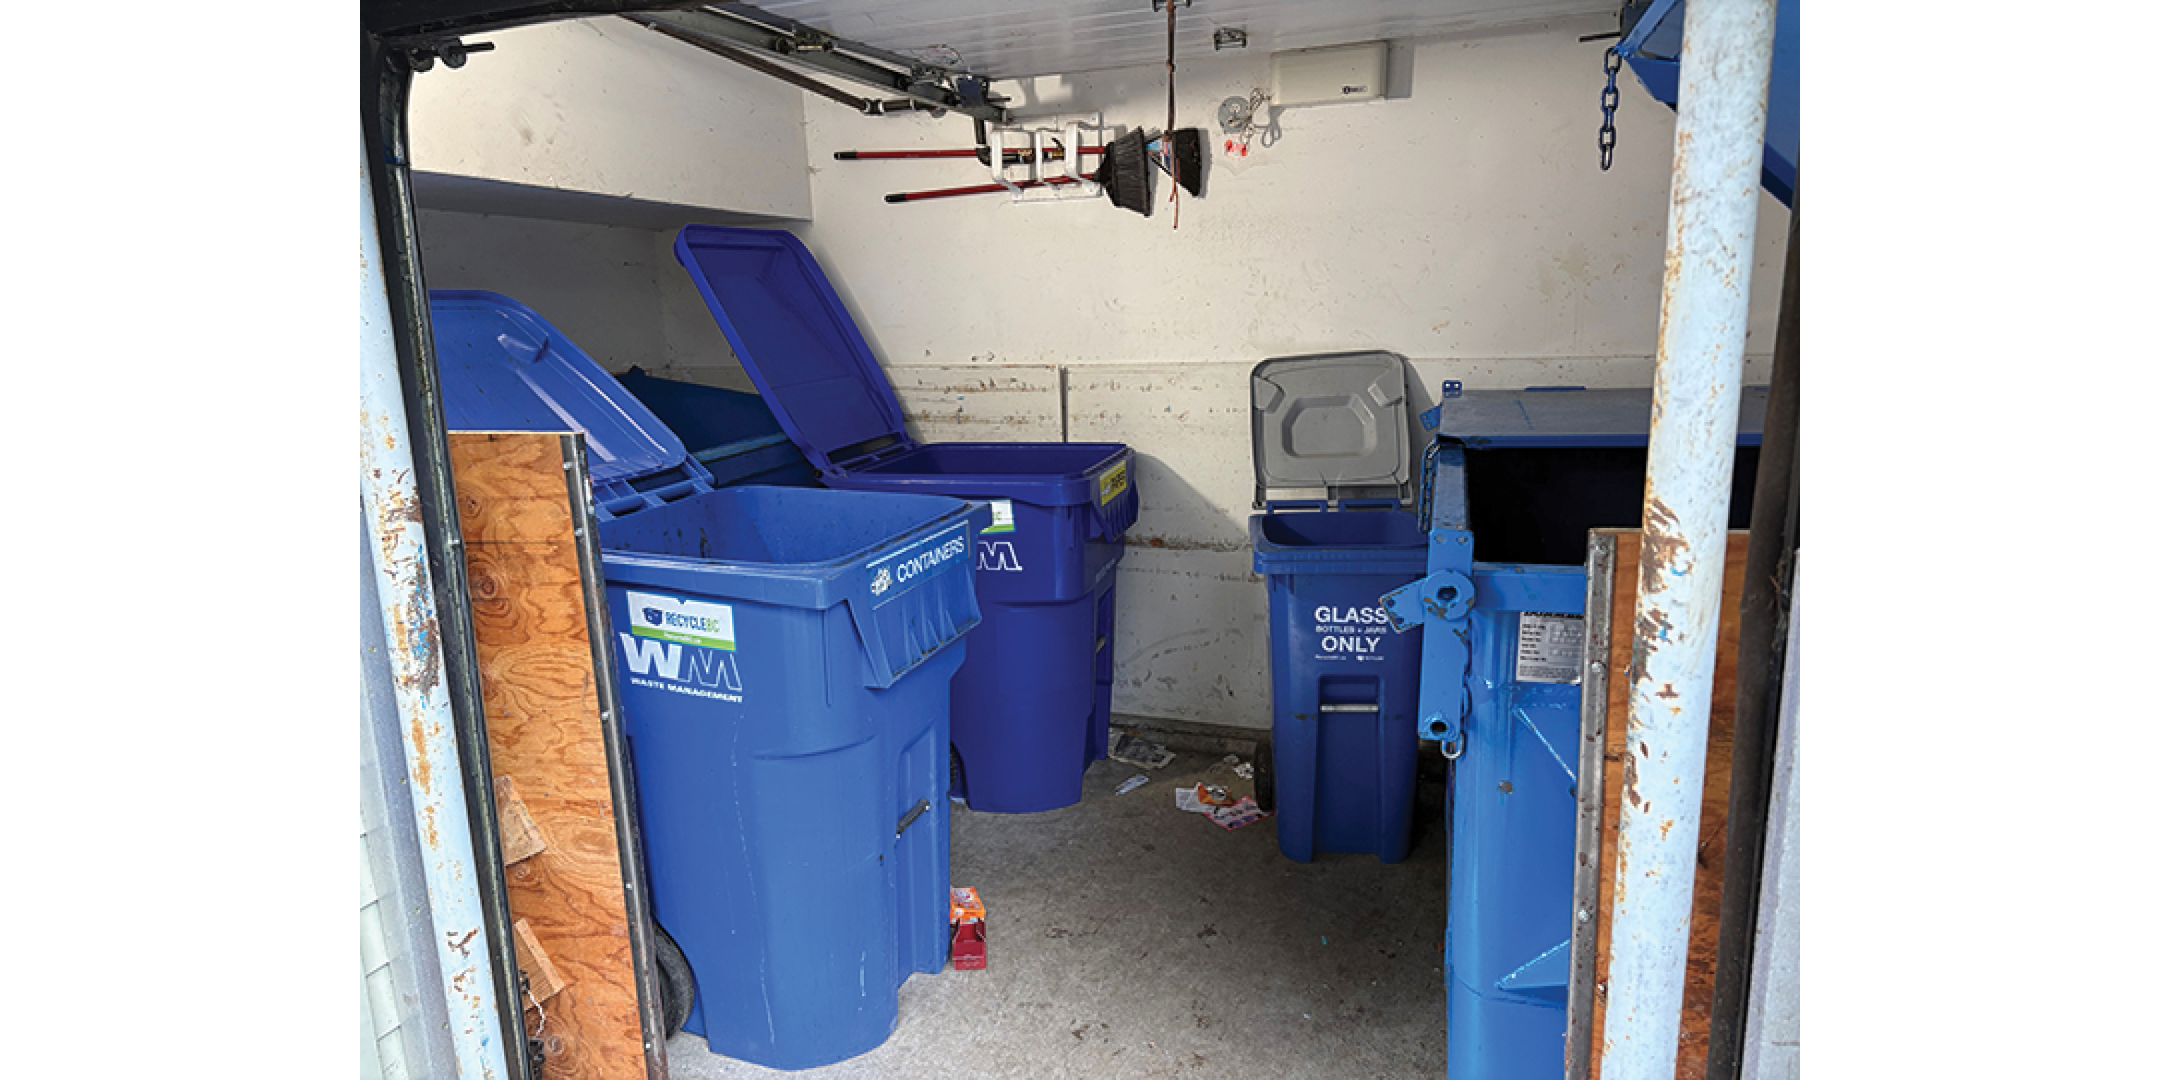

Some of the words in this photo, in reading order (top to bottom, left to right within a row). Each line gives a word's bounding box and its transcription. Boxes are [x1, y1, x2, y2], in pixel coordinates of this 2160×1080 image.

[897, 536, 965, 583] CONTAINERS
[976, 541, 1023, 571] M
[1314, 605, 1389, 625] GLASS
[1315, 625, 1355, 633] BOTTLES
[1321, 635, 1381, 653] ONLY
[619, 632, 743, 692] WM
[630, 677, 665, 690] WASTE
[667, 683, 743, 703] MANAGEMENT
